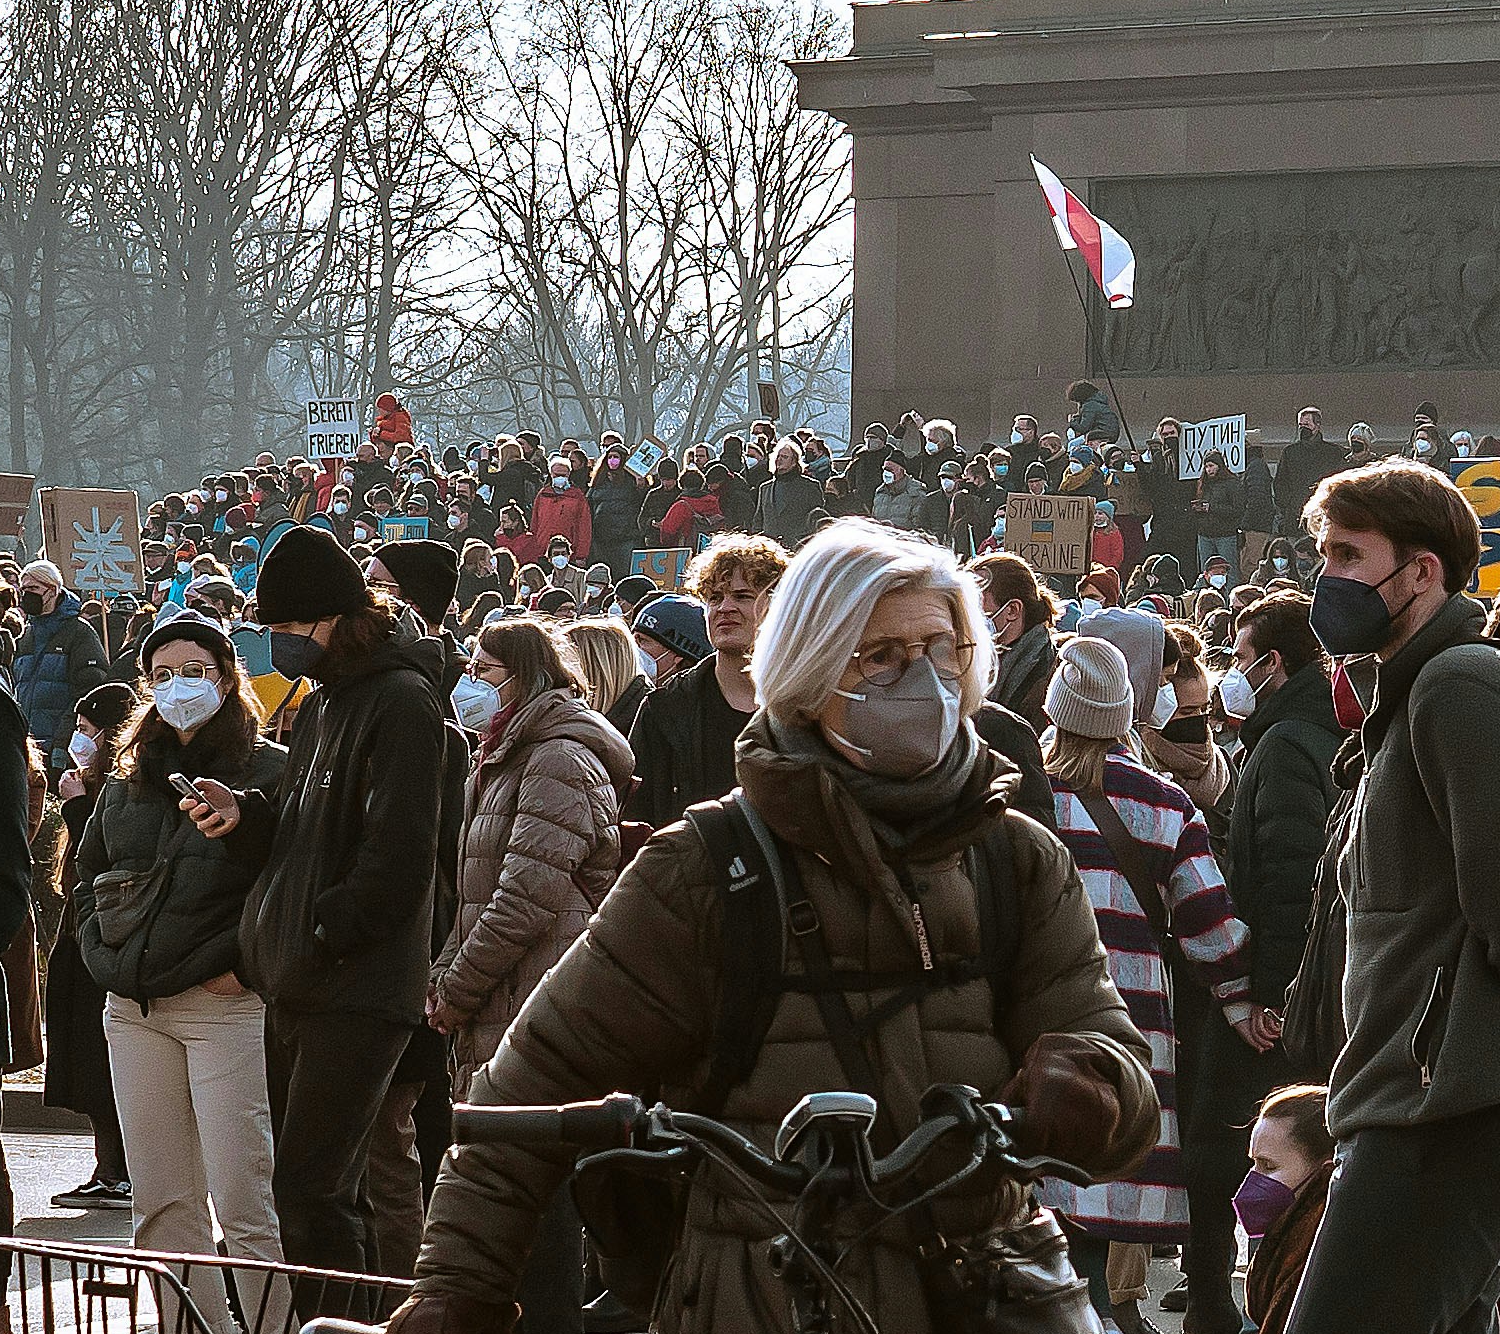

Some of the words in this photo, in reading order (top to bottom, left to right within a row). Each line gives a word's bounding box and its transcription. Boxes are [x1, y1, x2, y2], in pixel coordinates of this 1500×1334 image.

[308, 401, 355, 425] BEREIT
[309, 433, 359, 457] FRIEREN
[1184, 420, 1241, 450] ПУТИН
[1008, 497, 1053, 519] STAND
[1057, 499, 1084, 521] WITH
